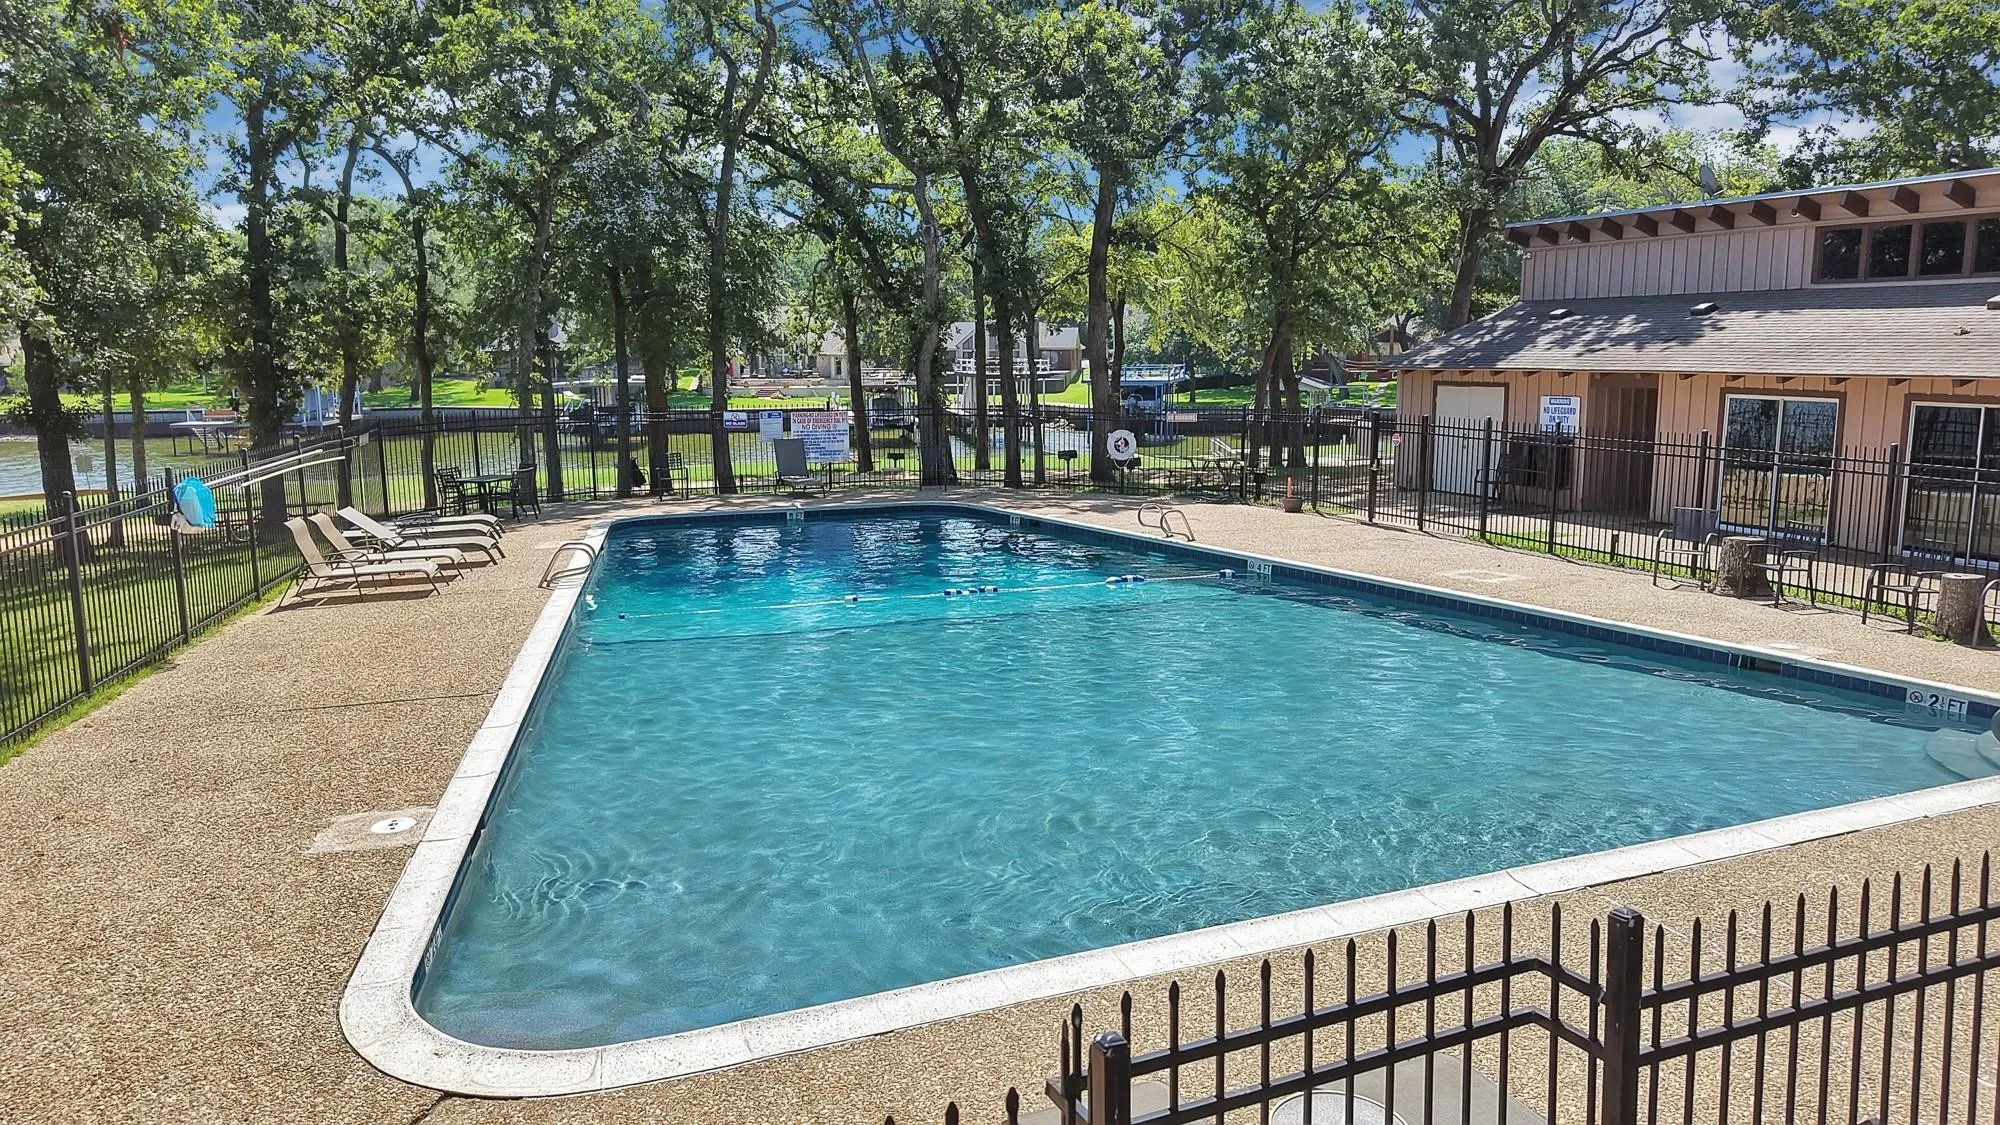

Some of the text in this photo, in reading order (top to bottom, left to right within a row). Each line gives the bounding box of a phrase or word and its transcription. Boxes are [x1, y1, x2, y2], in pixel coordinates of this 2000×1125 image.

[1551, 407, 1576, 415] LIFEGUARD
[1264, 564, 1270, 573] FT
[1947, 699, 1966, 713] FT
